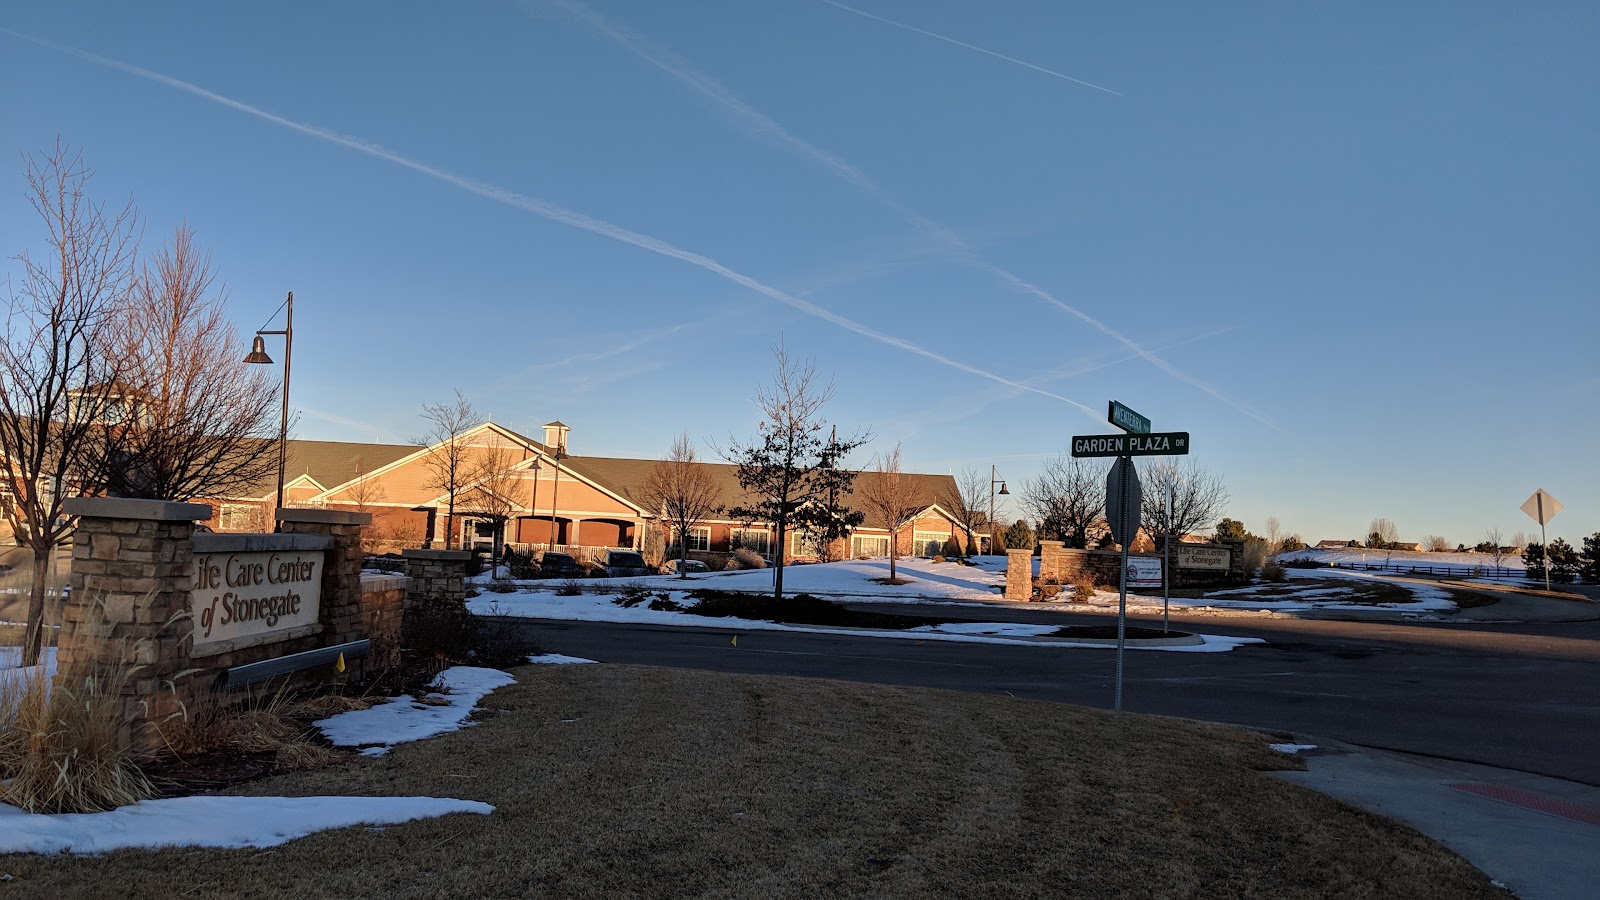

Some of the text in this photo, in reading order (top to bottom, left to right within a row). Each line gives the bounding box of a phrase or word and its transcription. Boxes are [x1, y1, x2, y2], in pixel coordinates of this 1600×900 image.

[1075, 437, 1185, 453] GARDEN PLAZA DR
[1192, 547, 1205, 556] Care
[1207, 548, 1227, 556] Center
[1184, 556, 1222, 566] of Stonegate
[193, 553, 316, 590] ife Care Center
[200, 589, 301, 638] of Stonegate
